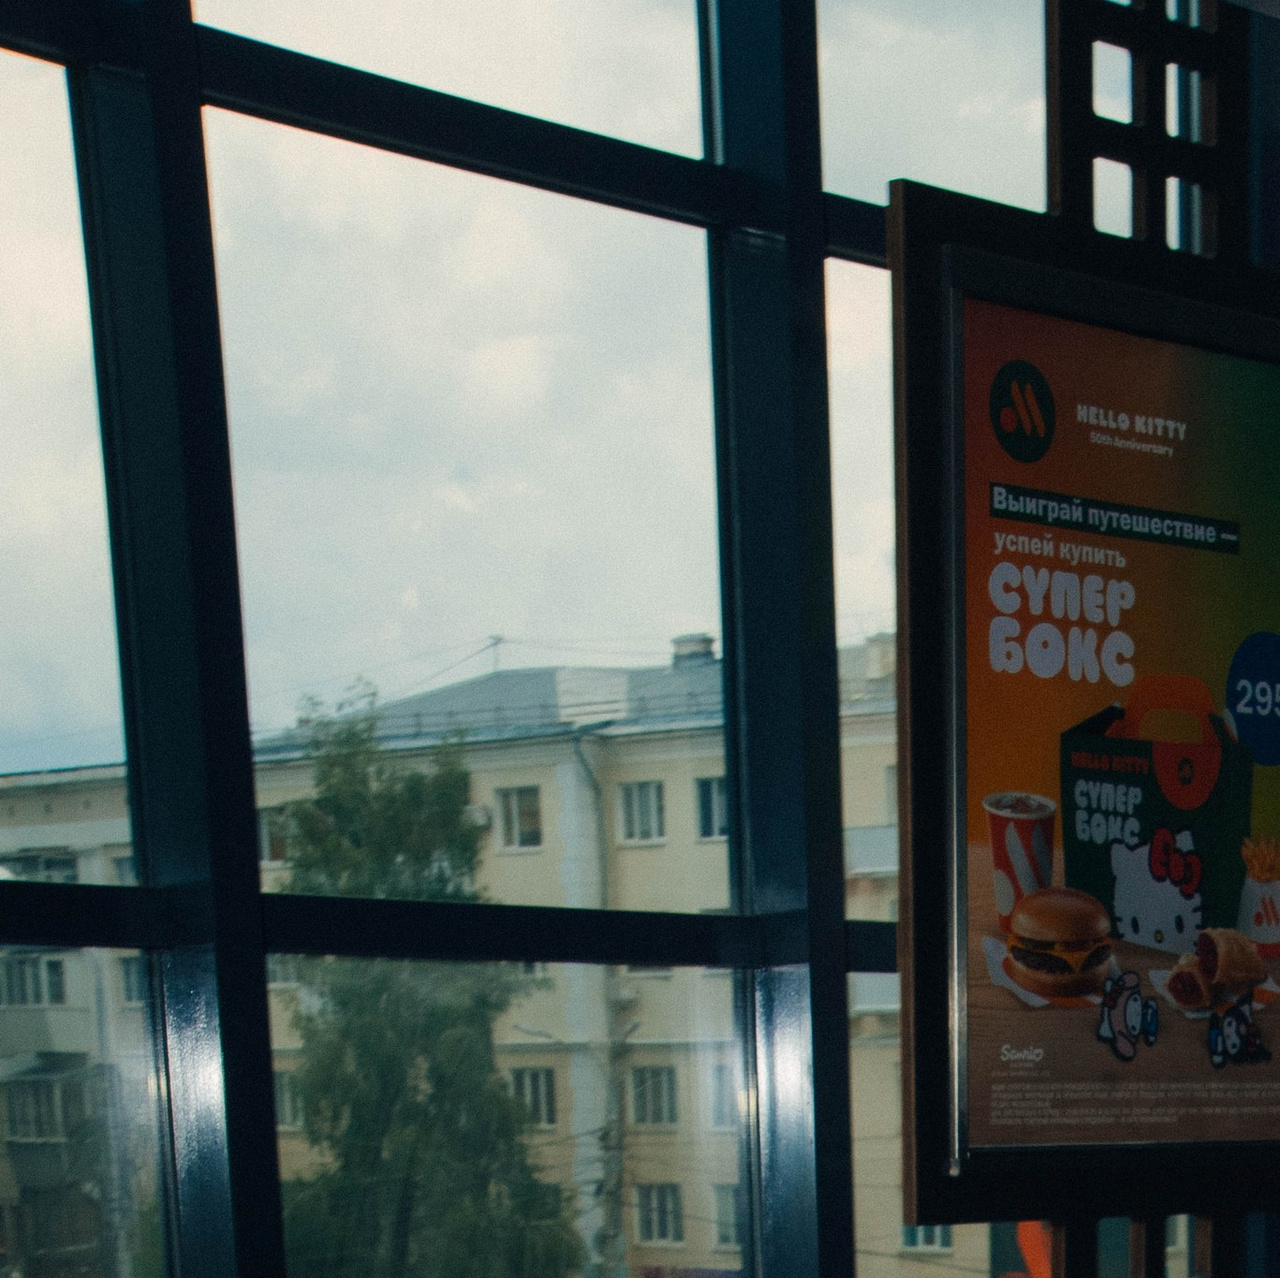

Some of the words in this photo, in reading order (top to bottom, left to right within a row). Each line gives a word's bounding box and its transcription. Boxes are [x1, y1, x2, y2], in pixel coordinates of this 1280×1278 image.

[1076, 403, 1130, 431] HELLO
[1134, 415, 1187, 440] KITTY
[992, 486, 1083, 522] Выиграй
[1087, 506, 1217, 543] путешествие
[994, 532, 1054, 556] успей
[1059, 541, 1127, 568] купить
[988, 561, 1136, 627] СУПЕР
[988, 616, 1136, 687] БОКС
[1074, 778, 1142, 815] СУПЕР
[1075, 808, 1140, 846] БОКС
